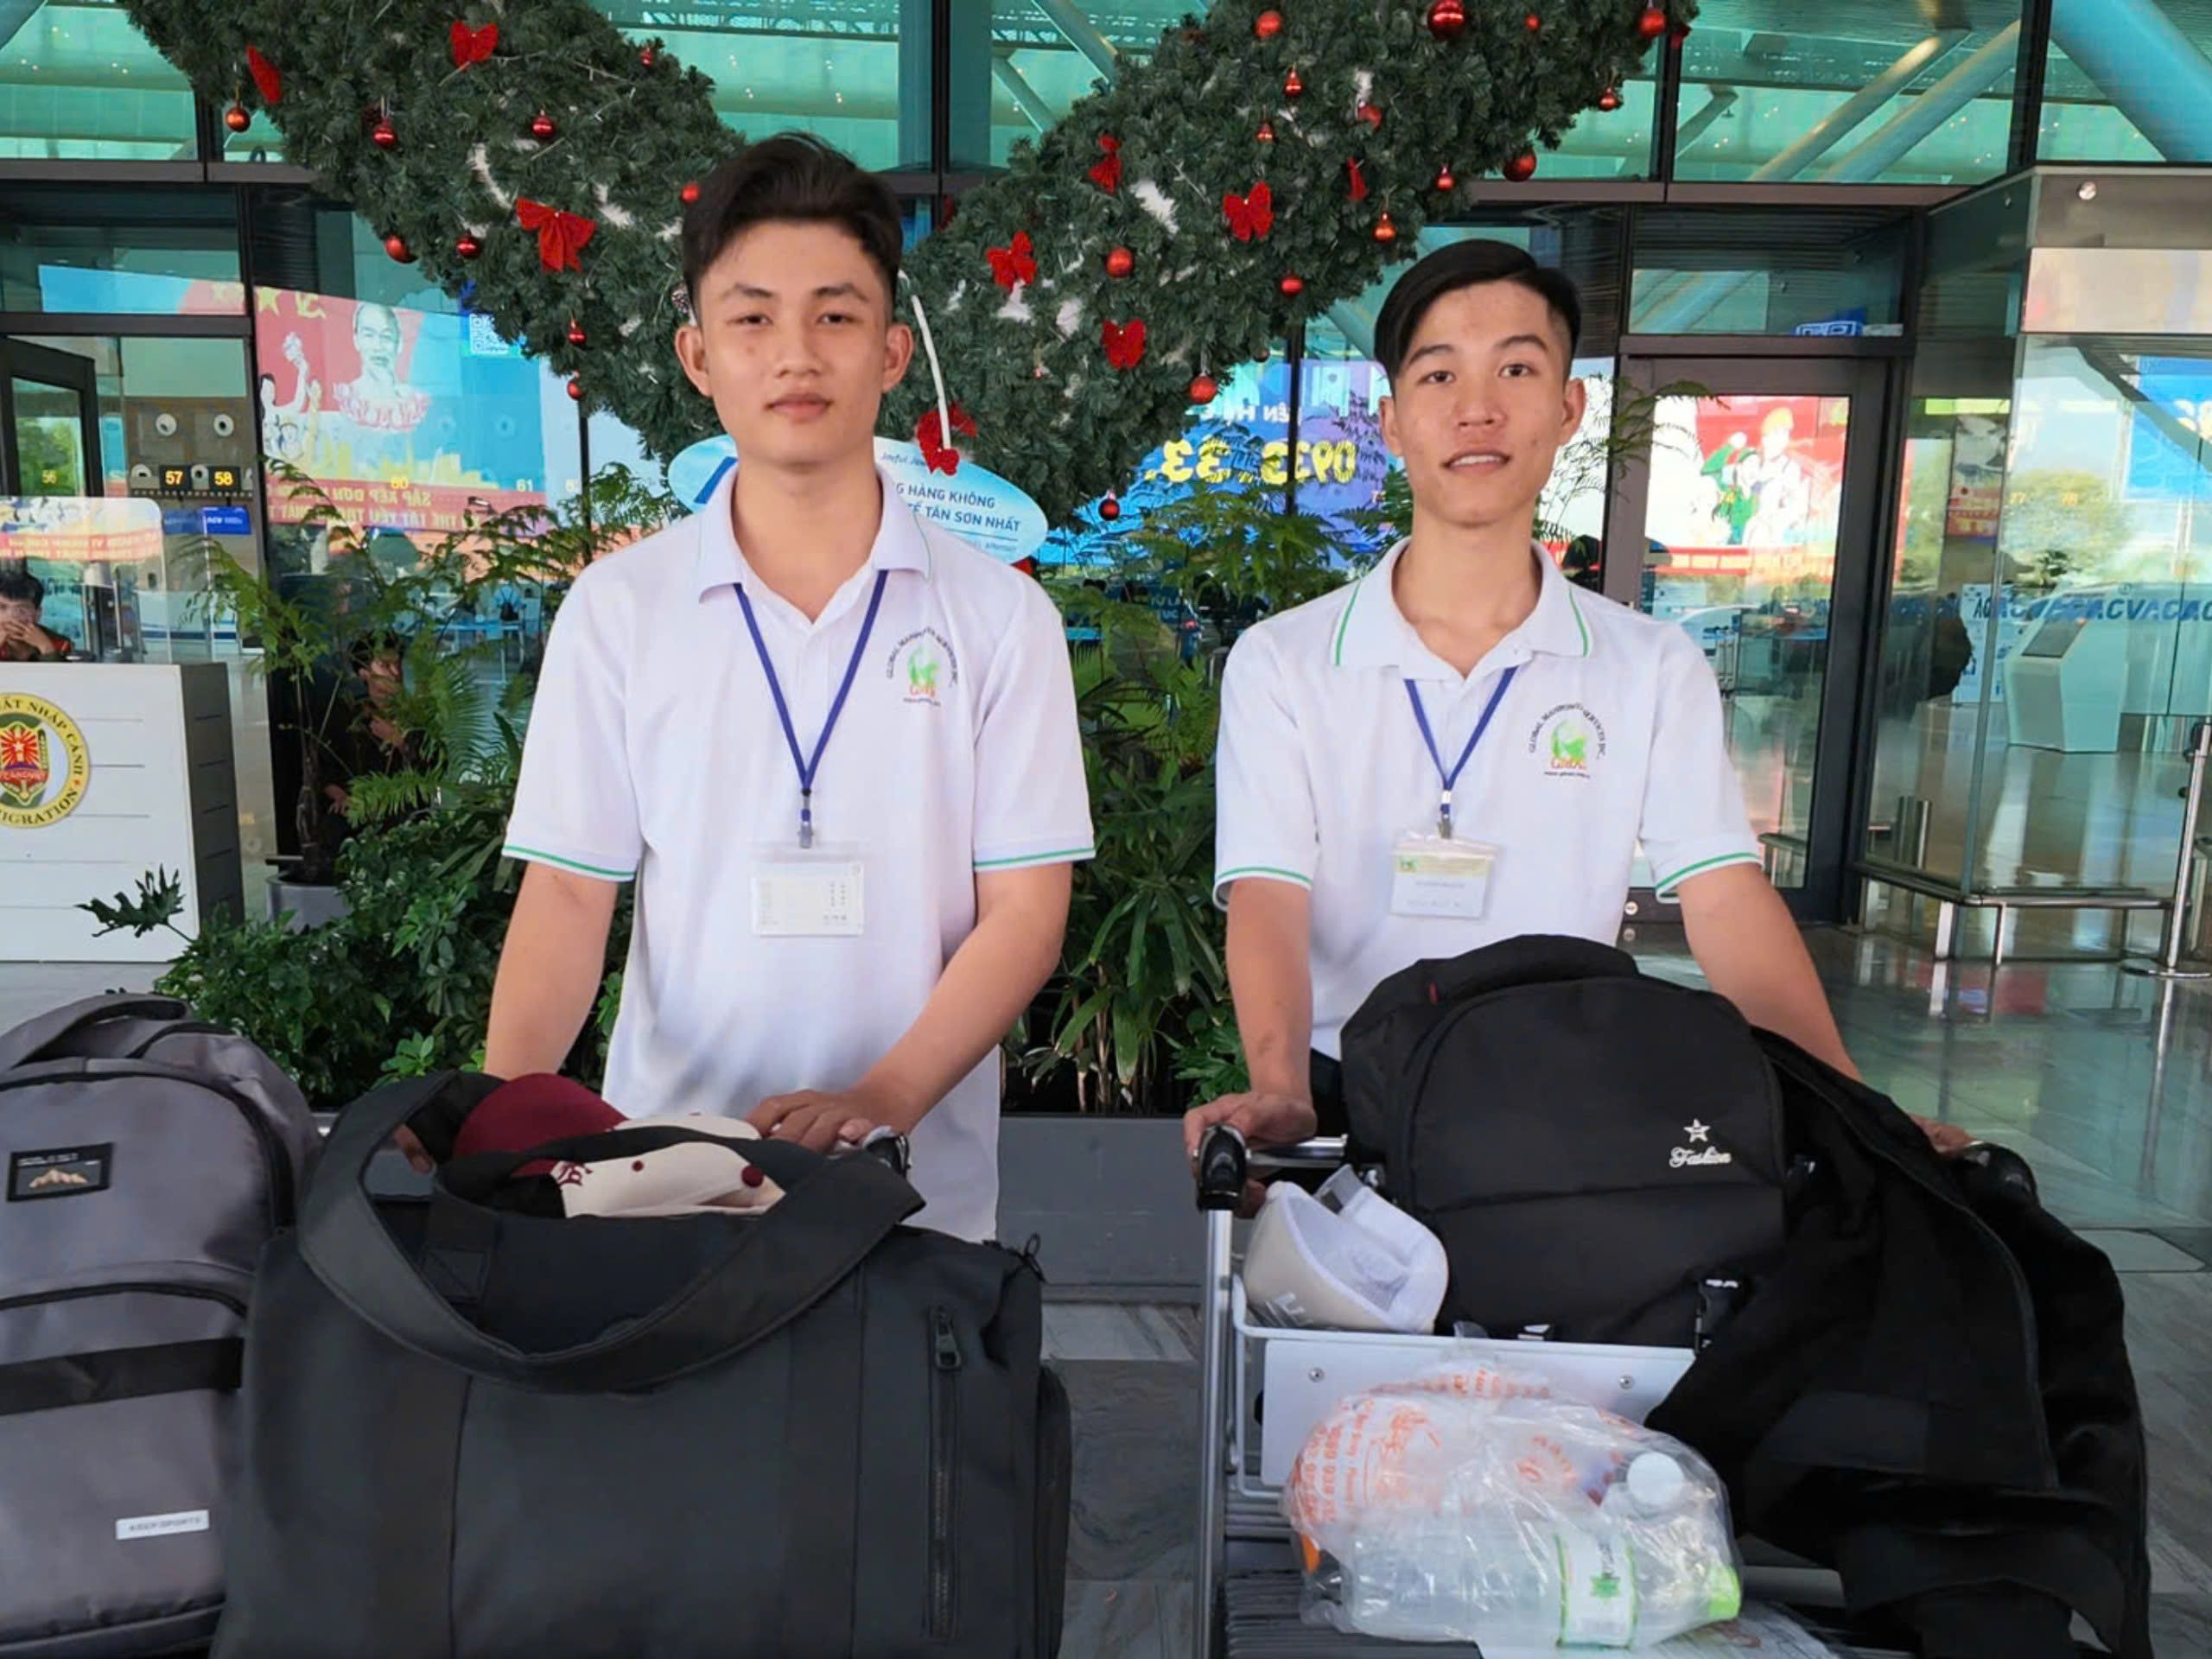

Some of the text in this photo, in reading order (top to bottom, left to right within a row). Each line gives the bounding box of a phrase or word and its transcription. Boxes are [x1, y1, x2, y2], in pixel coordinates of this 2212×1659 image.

[165, 470, 183, 486] 57
[214, 471, 234, 486] 58
[908, 484, 945, 501] HÀNG
[949, 489, 996, 510] KHÔNG
[925, 505, 951, 520] TÂN
[954, 511, 982, 525] SƠN
[985, 515, 1021, 532] NHẤT
